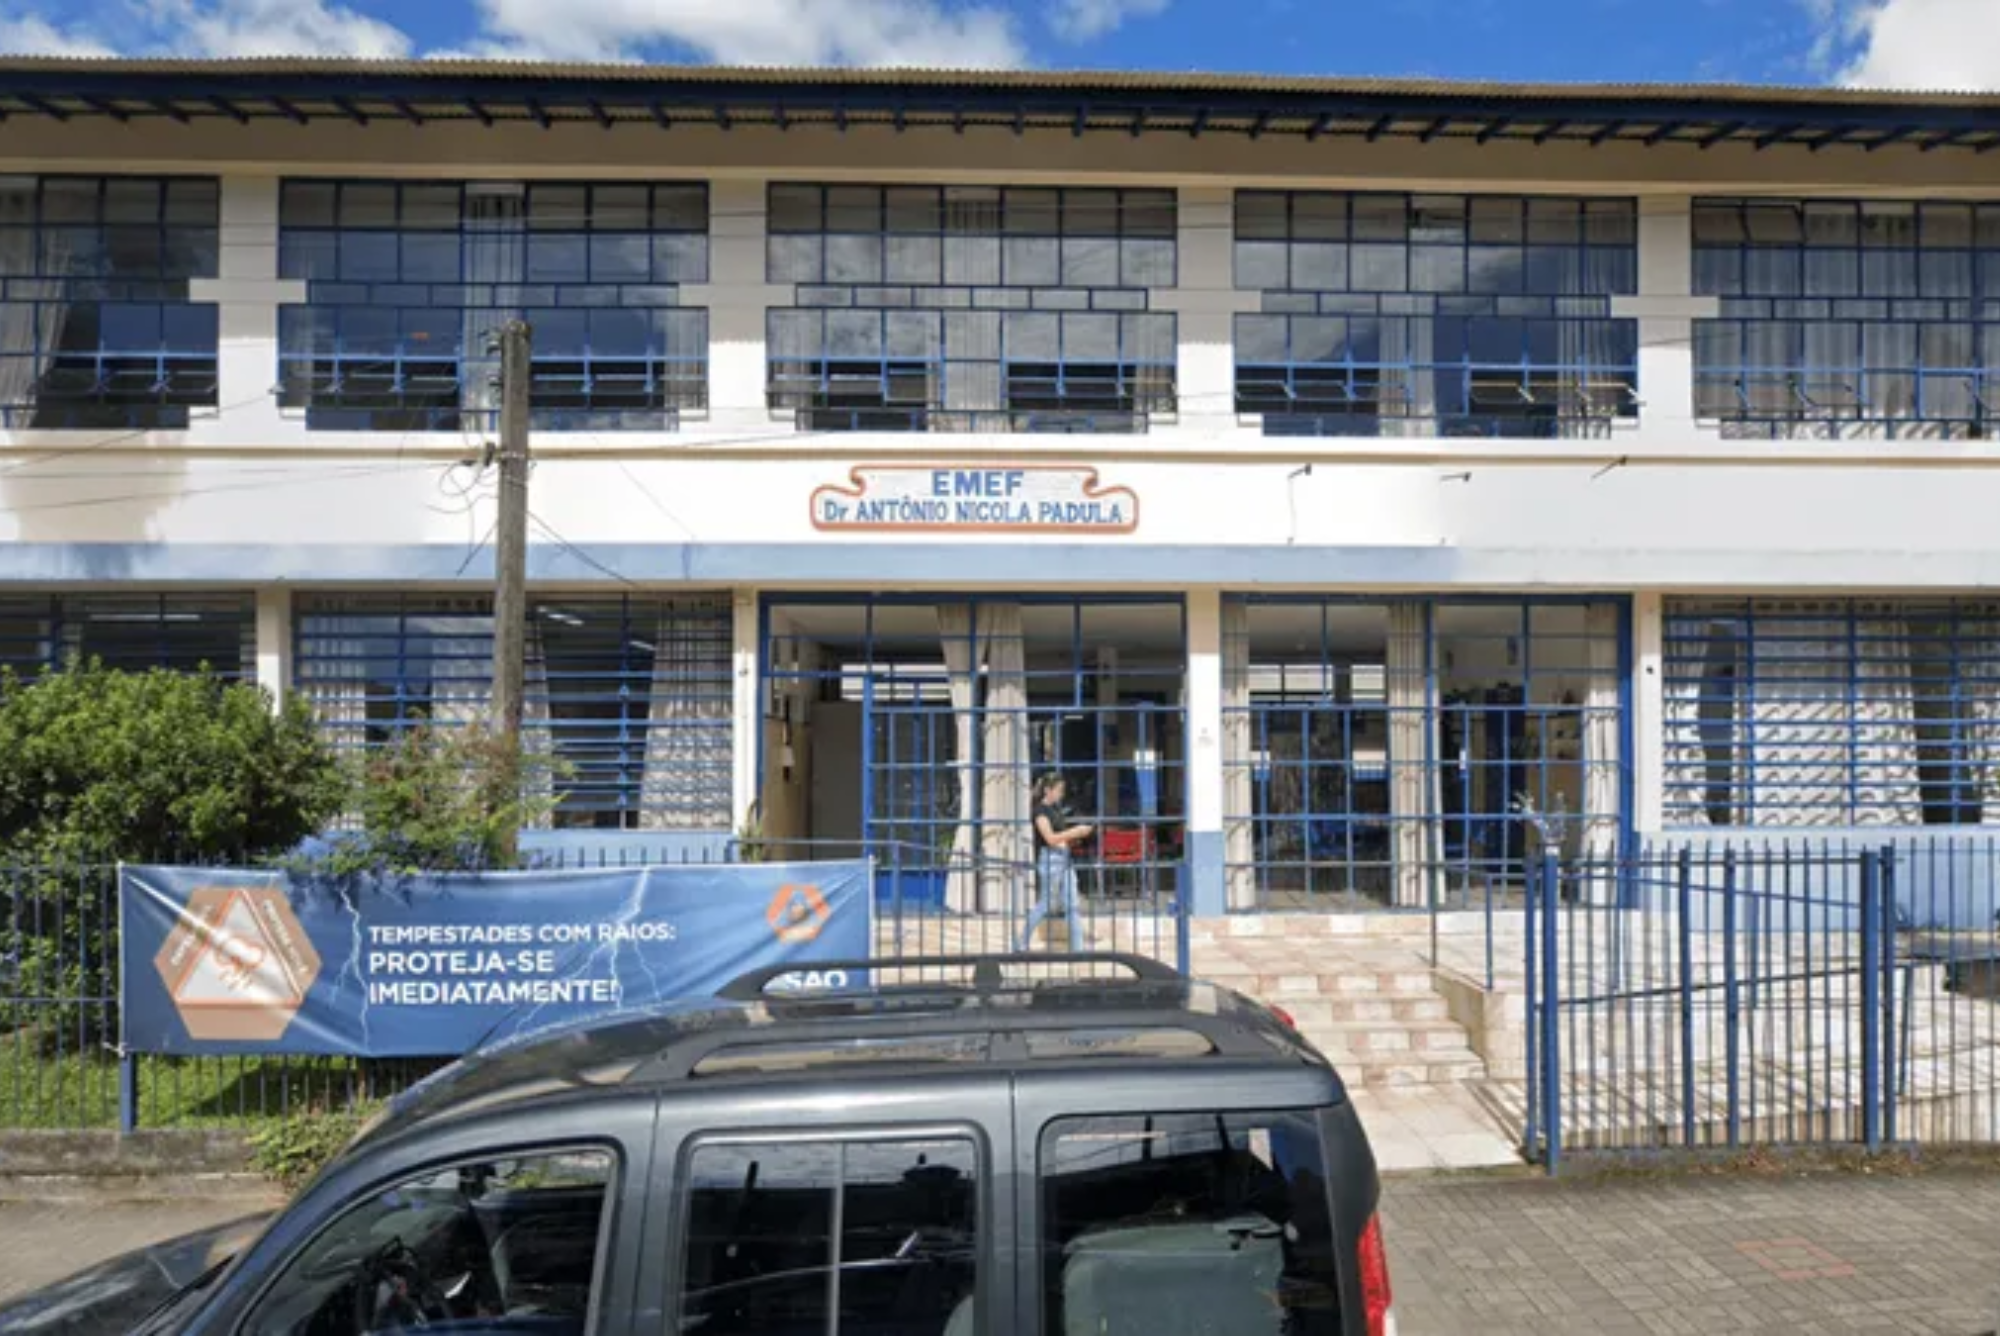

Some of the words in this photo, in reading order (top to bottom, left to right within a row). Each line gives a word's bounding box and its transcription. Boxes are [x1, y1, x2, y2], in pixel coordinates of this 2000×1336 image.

[932, 470, 1024, 497] EMEF
[824, 500, 849, 521] Dr
[855, 494, 948, 522] ANTÔNIO
[955, 501, 1032, 523] NICOLA
[1039, 501, 1122, 524] PADULA
[368, 925, 533, 944] TEMPESTADES
[538, 923, 591, 943] COM
[598, 922, 677, 942] RAIOS:
[369, 949, 555, 974] PROTEJA-SE
[369, 978, 620, 1005] IMEDIATAMENTE!
